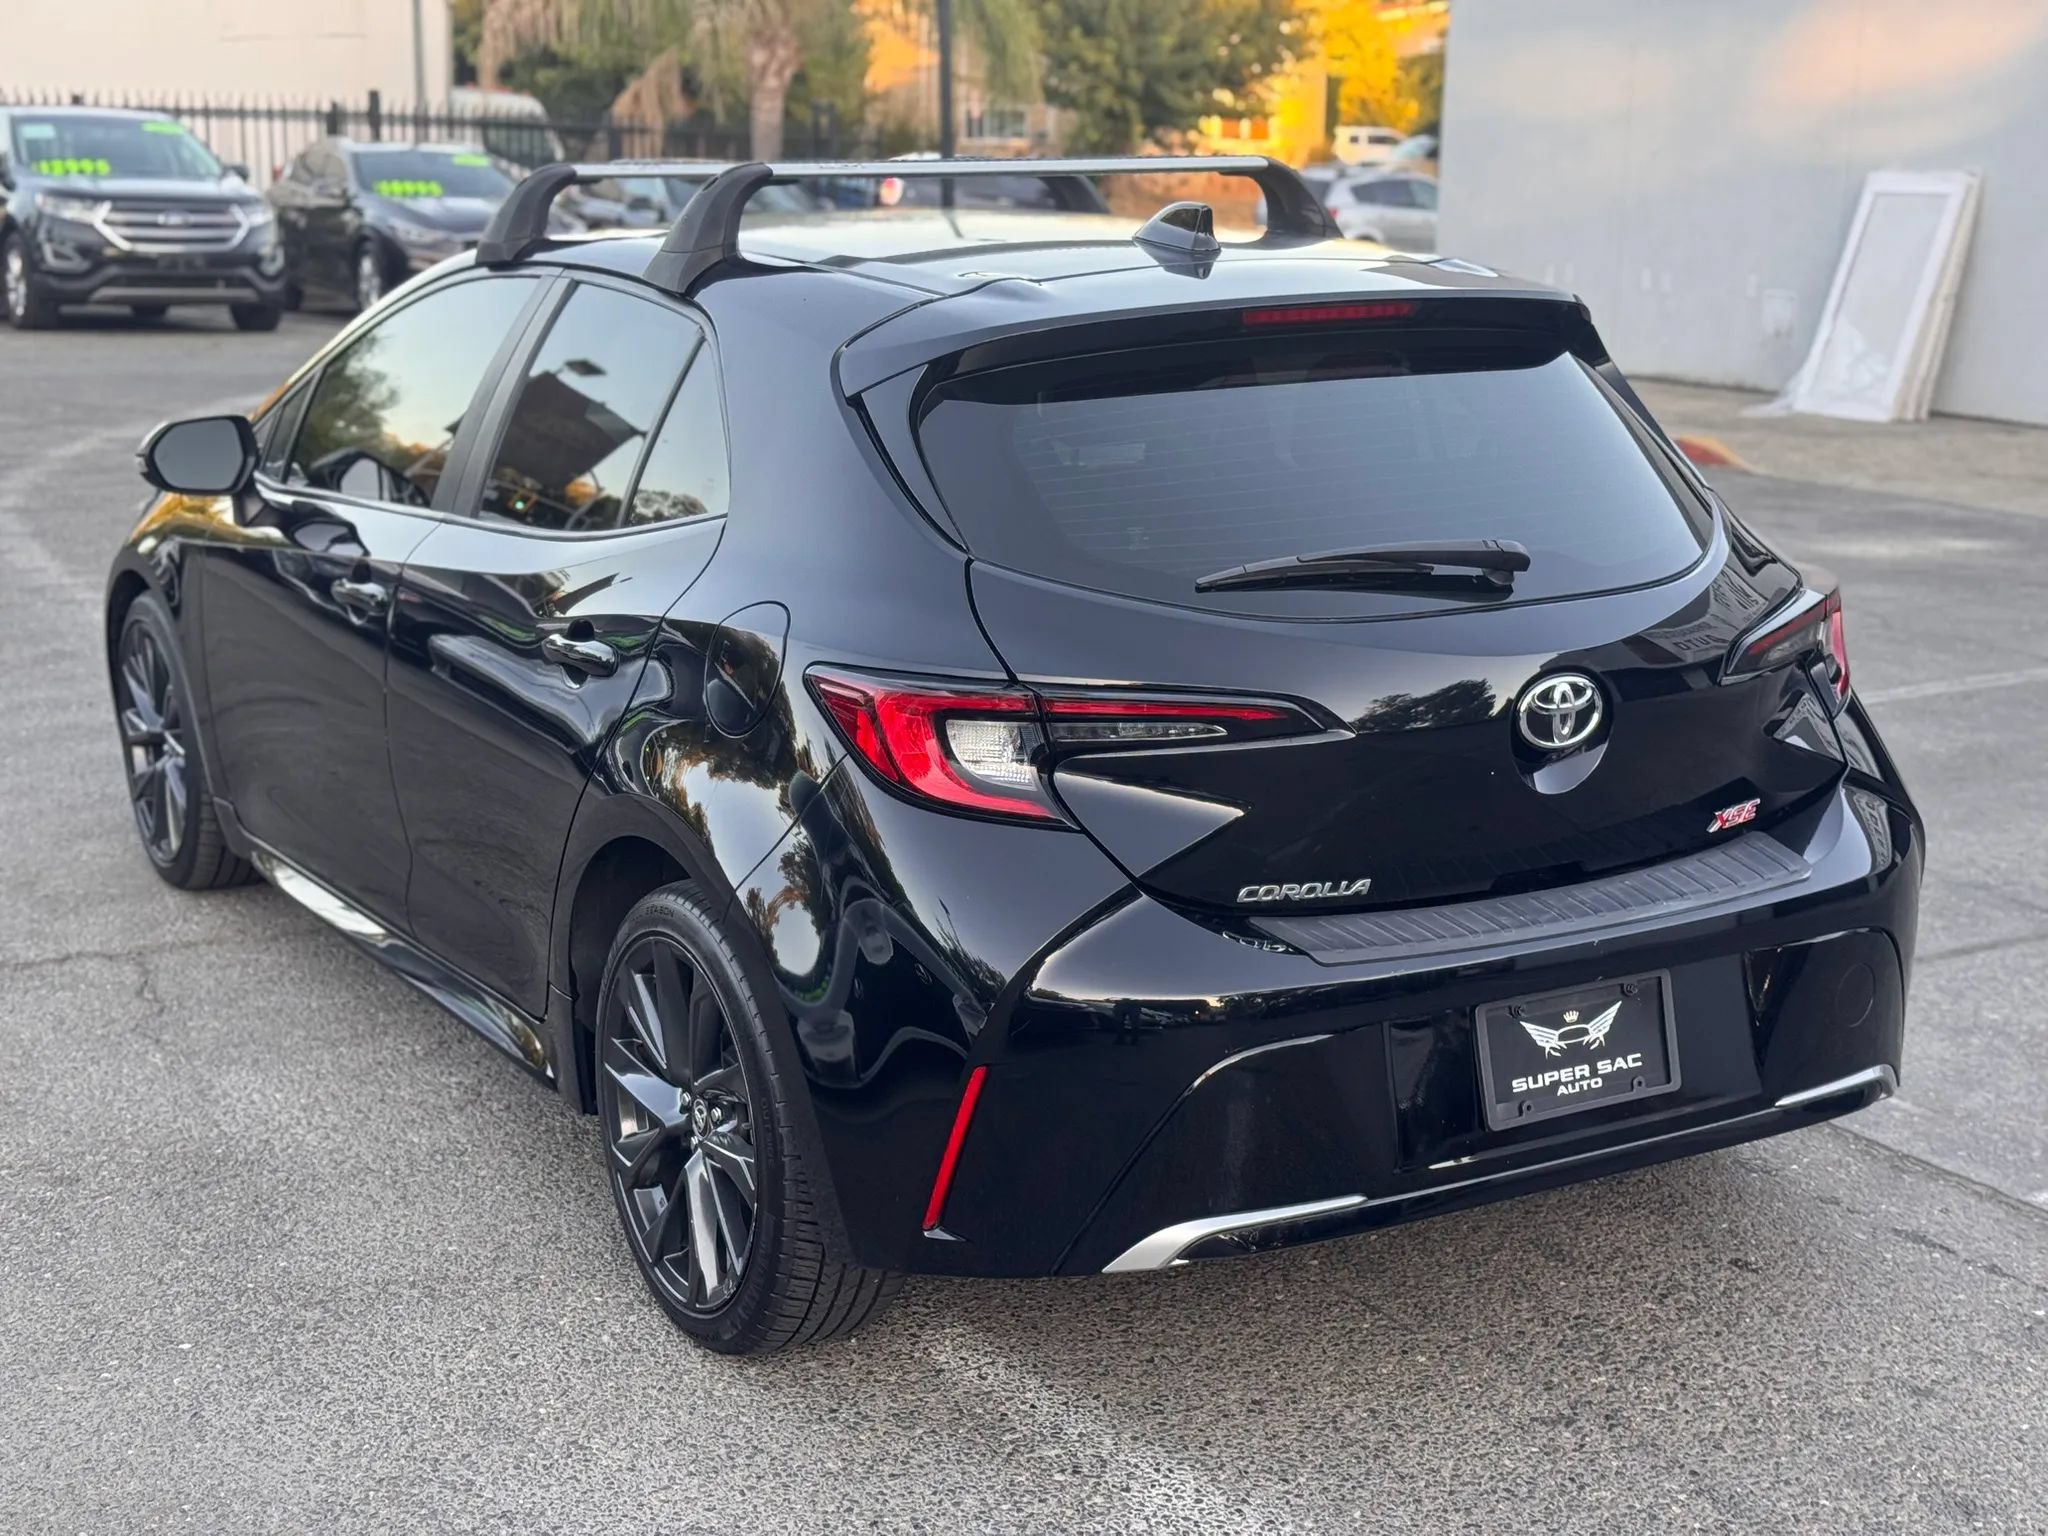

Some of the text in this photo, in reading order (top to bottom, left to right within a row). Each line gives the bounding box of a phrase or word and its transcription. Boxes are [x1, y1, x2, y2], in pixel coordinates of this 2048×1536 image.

[1706, 797, 1761, 833] XSE
[1236, 878, 1372, 903] COROLLA
[1512, 1053, 1643, 1093] SUPER SAC
[1557, 1078, 1604, 1097] AUTO
